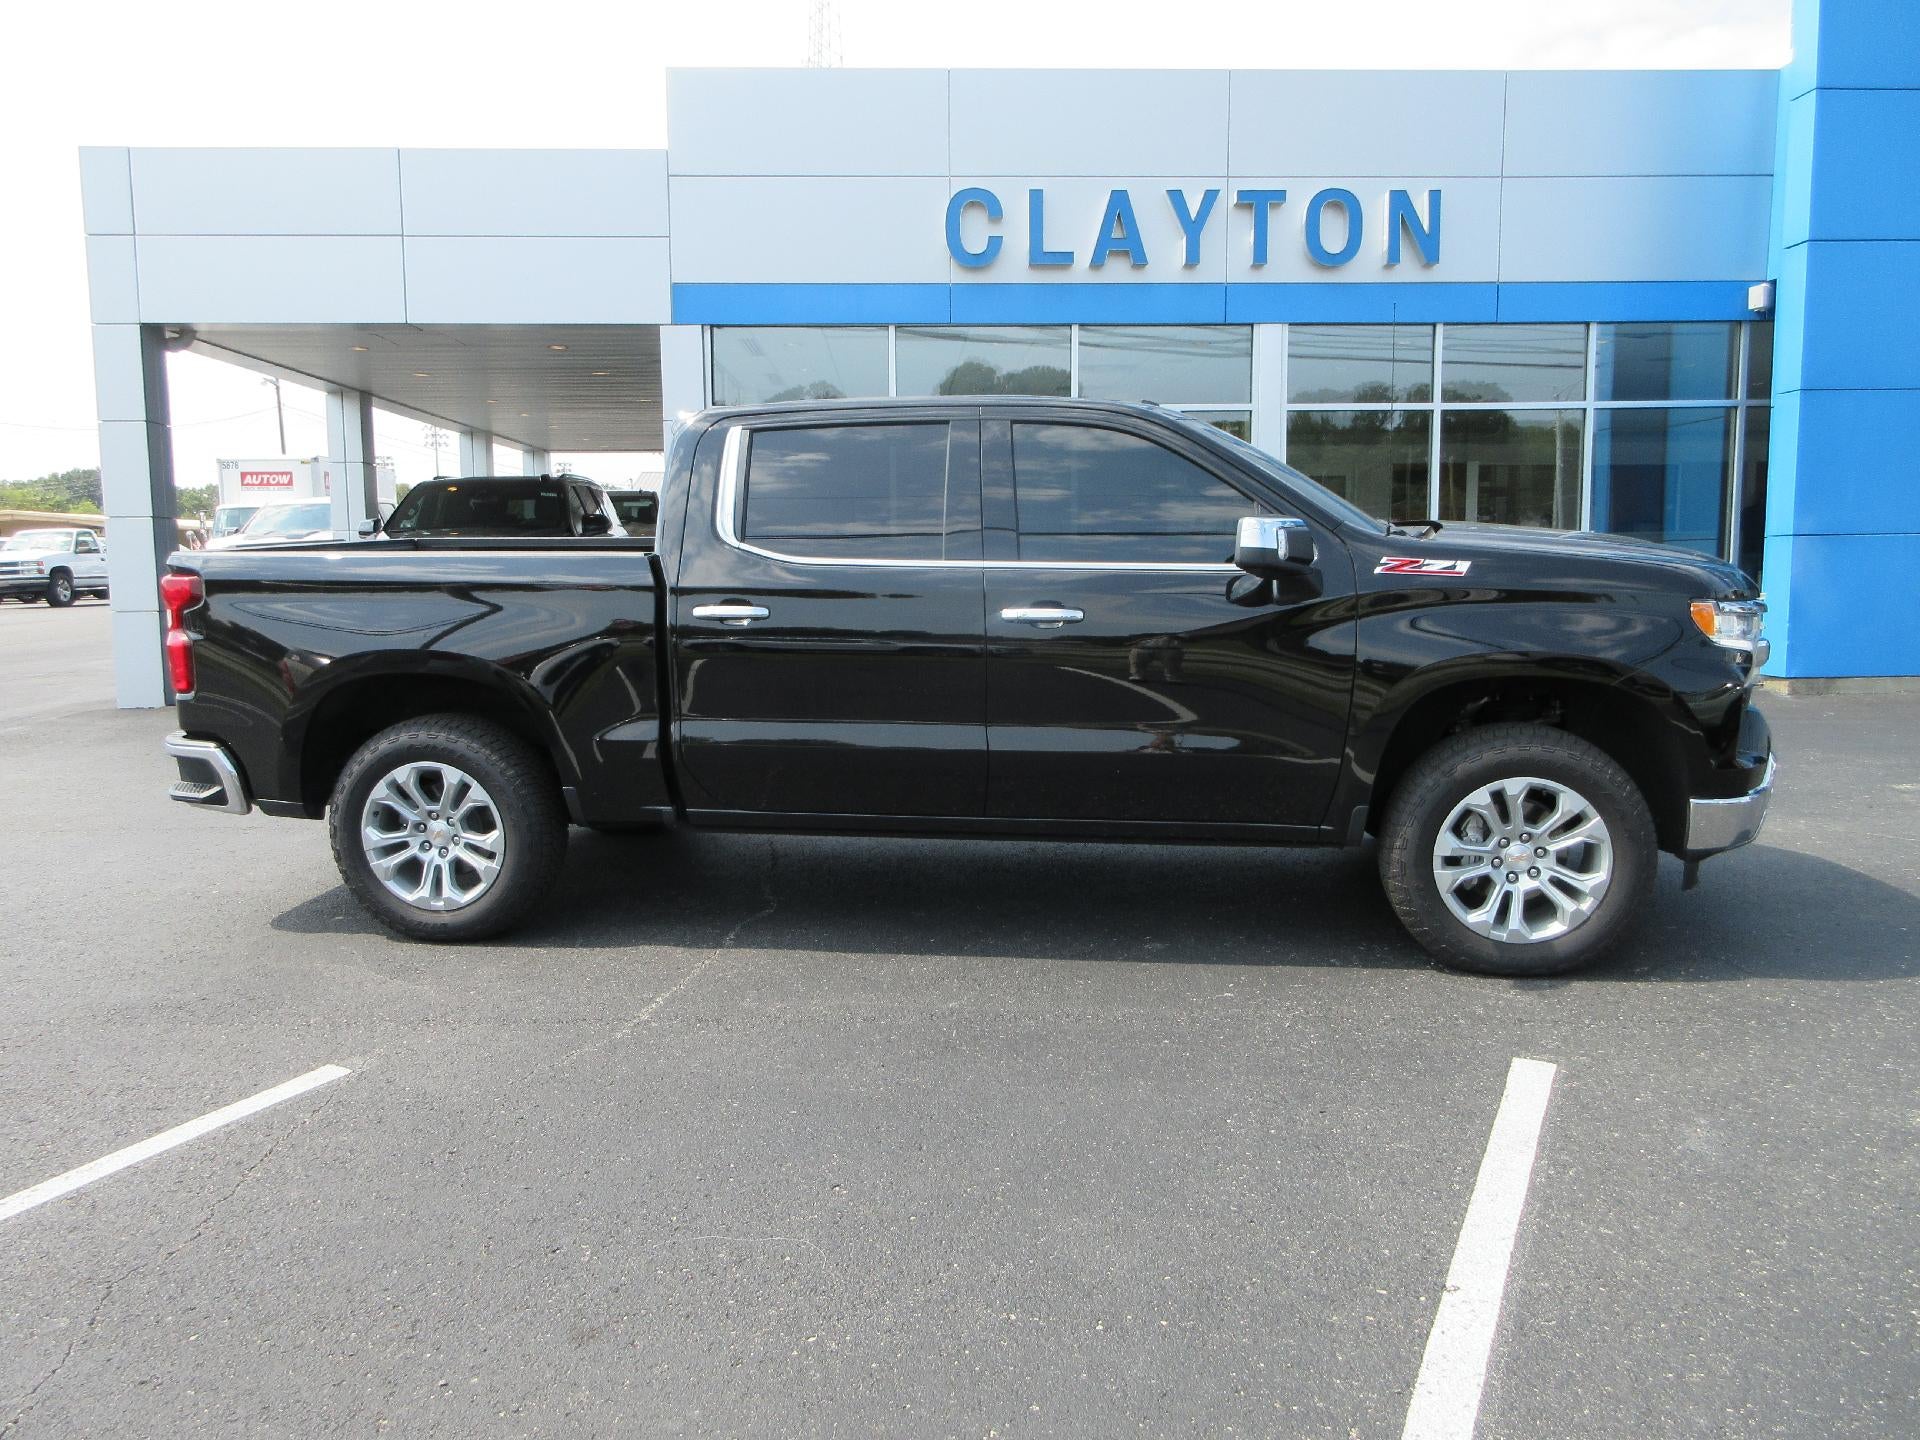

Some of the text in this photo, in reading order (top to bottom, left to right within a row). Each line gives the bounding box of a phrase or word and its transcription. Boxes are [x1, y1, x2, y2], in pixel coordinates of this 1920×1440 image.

[945, 187, 1442, 269] CLAYTON
[243, 474, 291, 485] AUTOW
[1374, 556, 1472, 577] Z71
